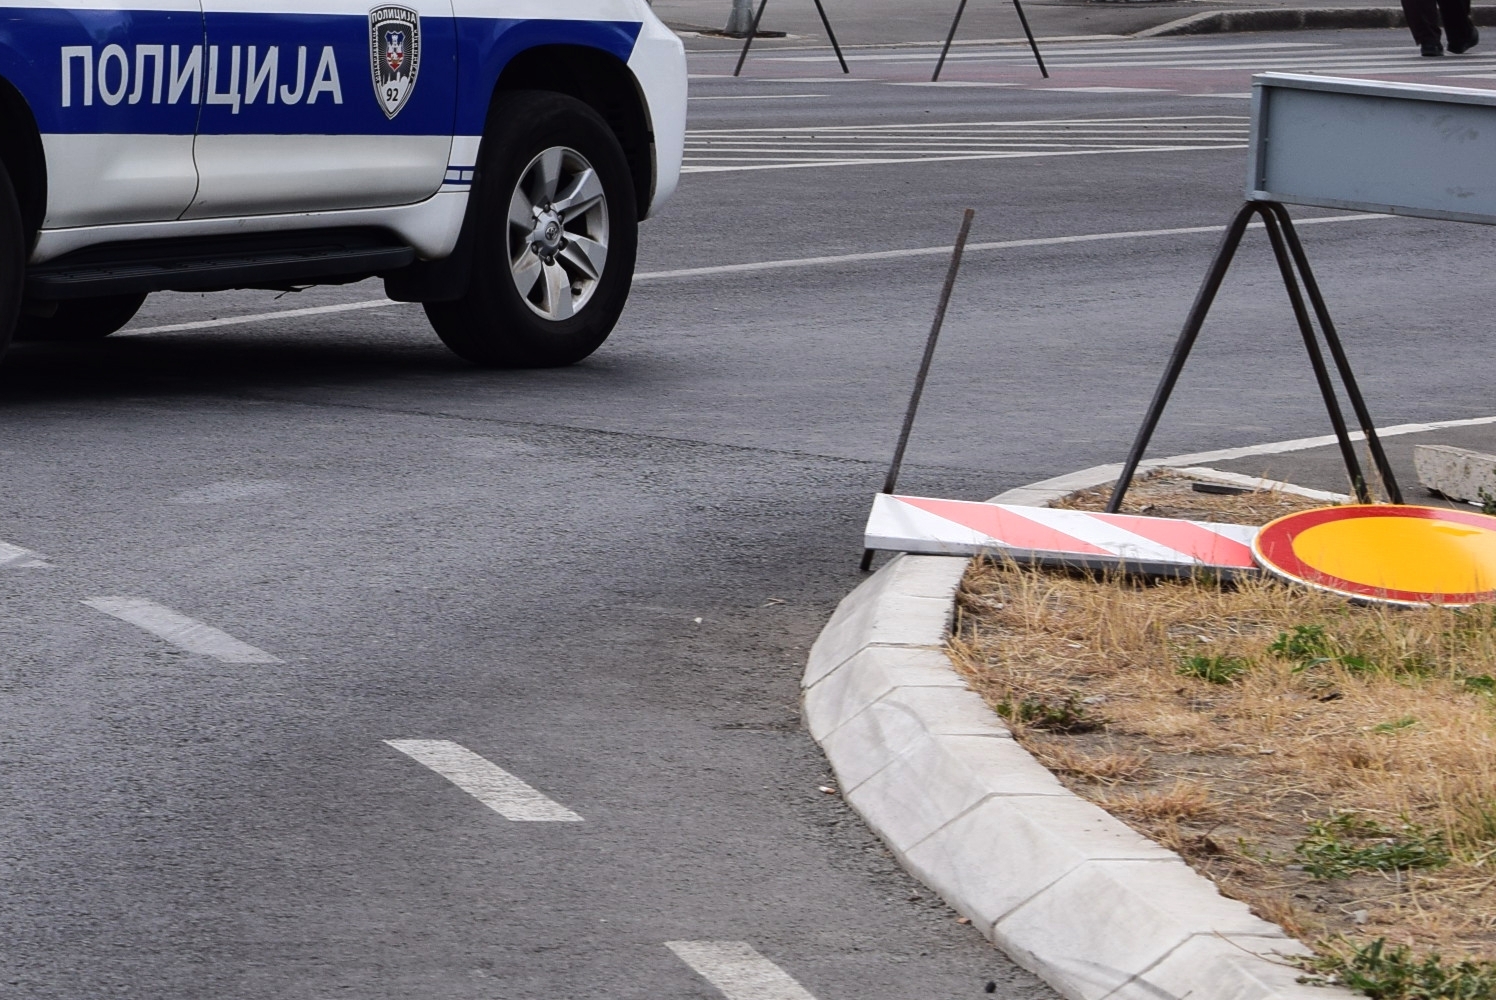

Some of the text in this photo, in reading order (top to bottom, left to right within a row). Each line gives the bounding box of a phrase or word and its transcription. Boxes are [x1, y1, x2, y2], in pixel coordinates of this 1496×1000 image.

[372, 8, 417, 24] ПОЛИЦИЈА
[61, 43, 343, 114] ПОЛИЦИЈА
[386, 87, 399, 102] 92
